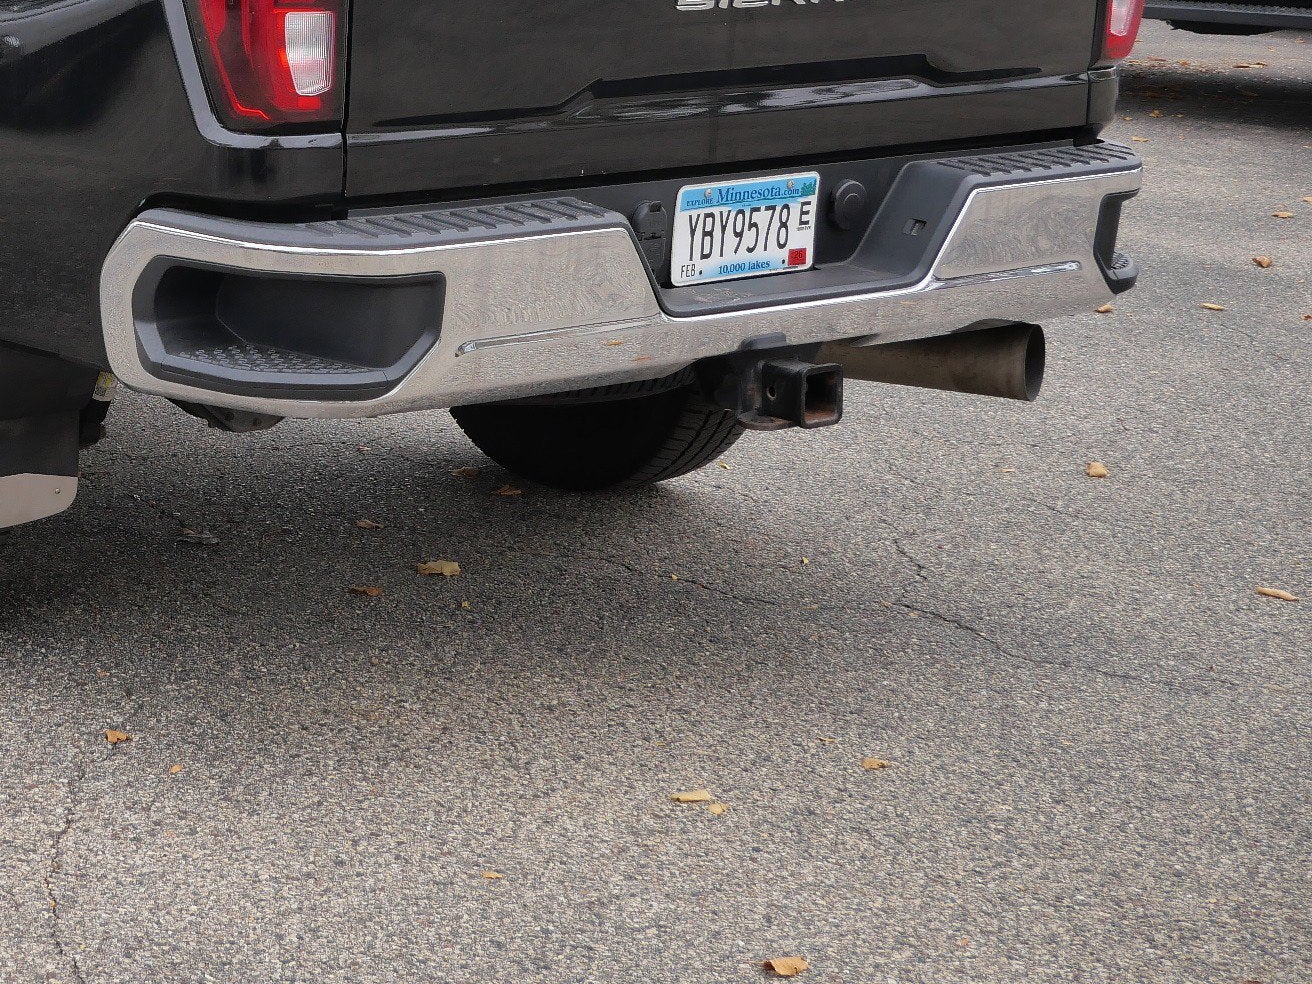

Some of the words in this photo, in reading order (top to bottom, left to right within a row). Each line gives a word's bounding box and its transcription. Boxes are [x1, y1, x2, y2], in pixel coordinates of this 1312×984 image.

[686, 197, 714, 207] EXPLORE
[716, 186, 800, 204] Minnesota.com
[798, 200, 812, 226] E
[688, 203, 791, 262] YBY9578
[680, 263, 696, 279] FEB
[718, 262, 746, 275] 10,000
[747, 260, 771, 271] lakes
